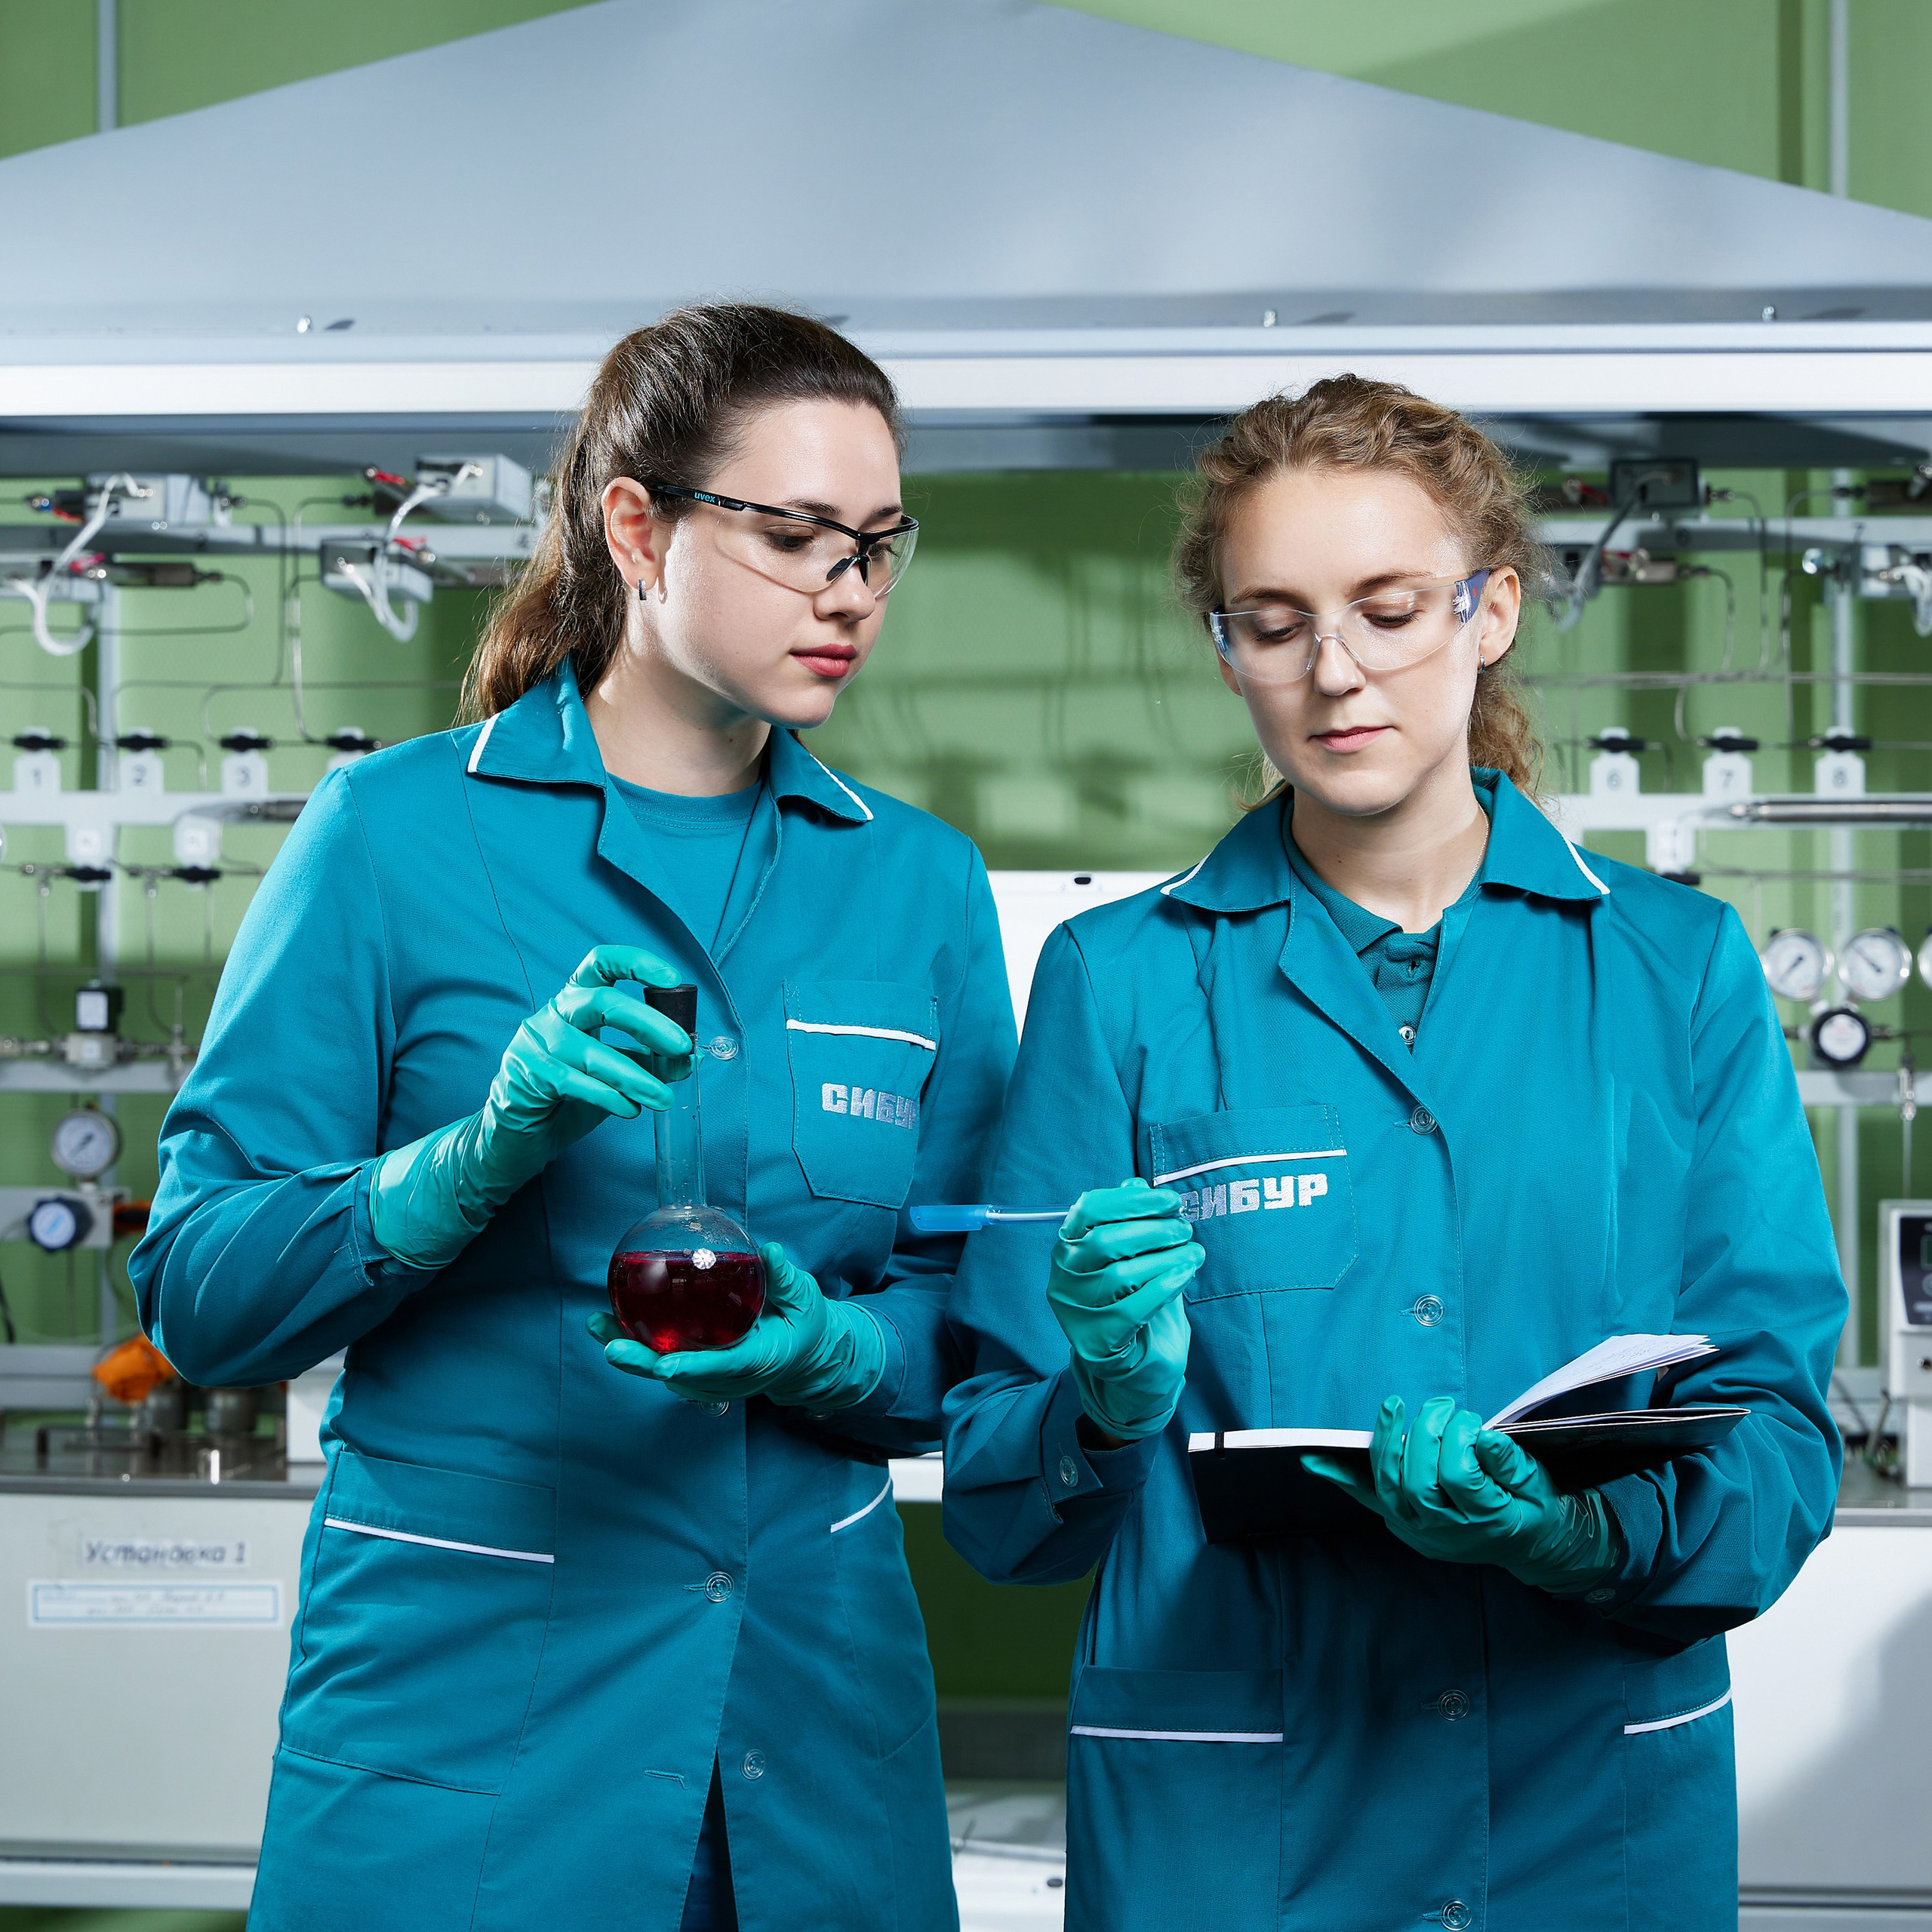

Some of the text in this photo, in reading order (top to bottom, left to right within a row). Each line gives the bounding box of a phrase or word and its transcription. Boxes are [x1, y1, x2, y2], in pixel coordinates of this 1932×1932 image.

[694, 492, 715, 503] uvex
[33, 768, 42, 786] 1
[133, 765, 147, 786] 2
[236, 765, 251, 786] 3
[1607, 768, 1622, 790] 6
[1720, 769, 1734, 789] 7
[1832, 766, 1848, 789] 8
[1180, 1173, 1328, 1223] СИБУР
[85, 1539, 246, 1564] Установка 1
